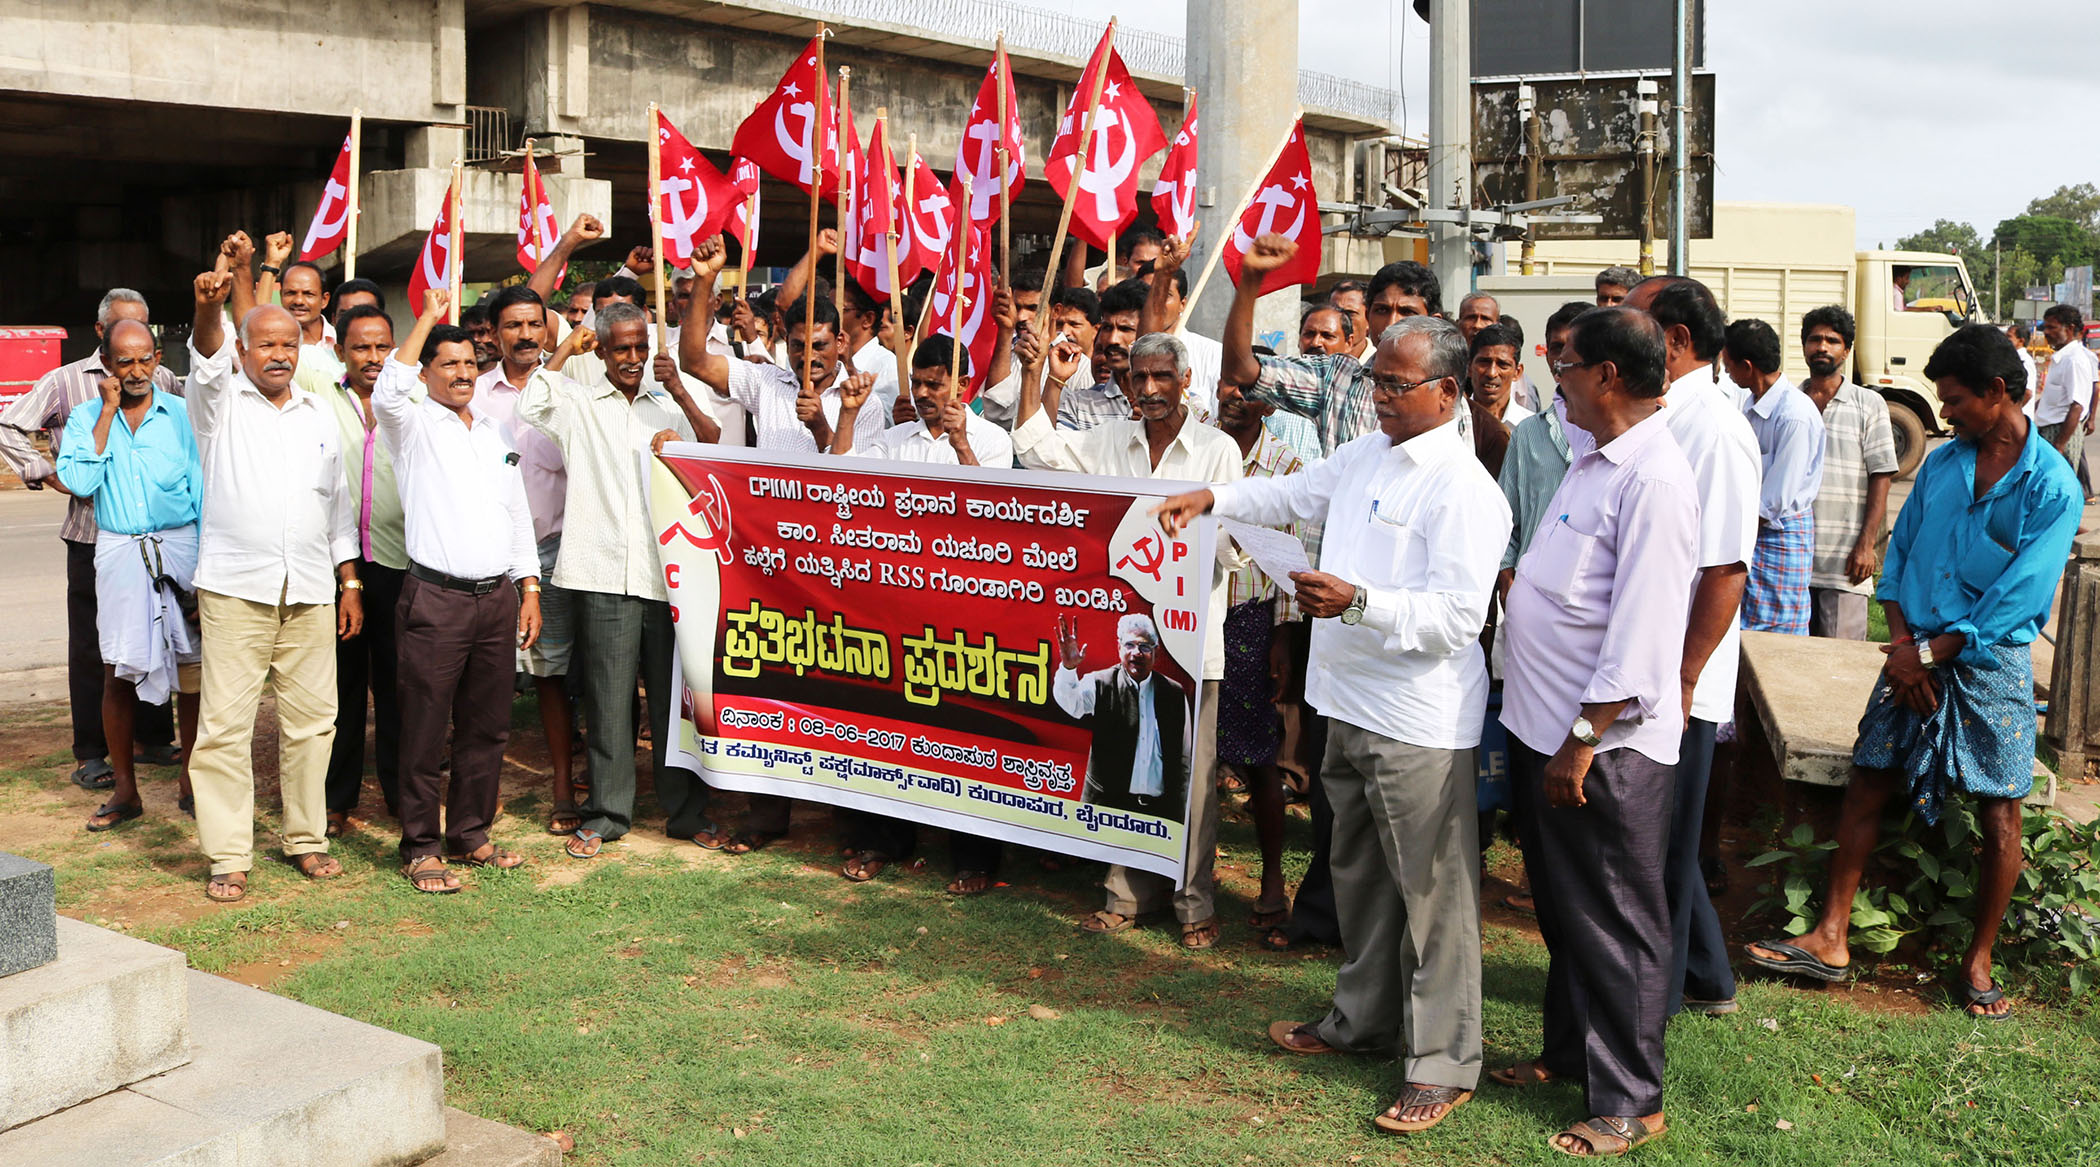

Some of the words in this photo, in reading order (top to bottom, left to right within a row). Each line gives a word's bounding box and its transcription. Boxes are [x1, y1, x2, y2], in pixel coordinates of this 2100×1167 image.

[748, 477, 802, 500] CPI(M)
[806, 484, 885, 519] ರಾಷ್ಟ್ರೀಯ
[895, 487, 955, 518] ಪ್ರಧಾನ
[966, 497, 1090, 527] ಕಾರ್ಯದರ್ಶಿ
[777, 521, 822, 543] ಕಾಂ.
[830, 524, 922, 554] ಸೀತರಾಮ
[931, 534, 1012, 564] ಯಚೂರಿ
[1022, 543, 1077, 571] ಮೇಲೆ
[743, 546, 786, 576] ಹಲ್ಲೆಗೆ
[795, 553, 871, 588] ಯತ್ನಿಸಿದ
[879, 563, 924, 589] RSS
[930, 568, 1044, 603] ಗೂಂಡಾಗಿರಿ
[1055, 588, 1127, 613] ಖಂಡಿಸಿ
[723, 601, 890, 679] ಪ್ರತಿಭಟನಾ
[903, 627, 1049, 707] ಪ್ರದರ್ಶನ
[720, 707, 785, 730] ದಿನಾಂಕ
[787, 718, 796, 733] :
[799, 717, 906, 751] 08-06-2017
[911, 735, 998, 769] ಕುಂದಾಪುರ
[726, 742, 814, 777] ಕಮ್ಯುನಿಸ್ಟ್
[968, 782, 1070, 822] ಕುಂದಾಪುರ,
[1076, 804, 1172, 841] ಬೈಂದೂರು.
